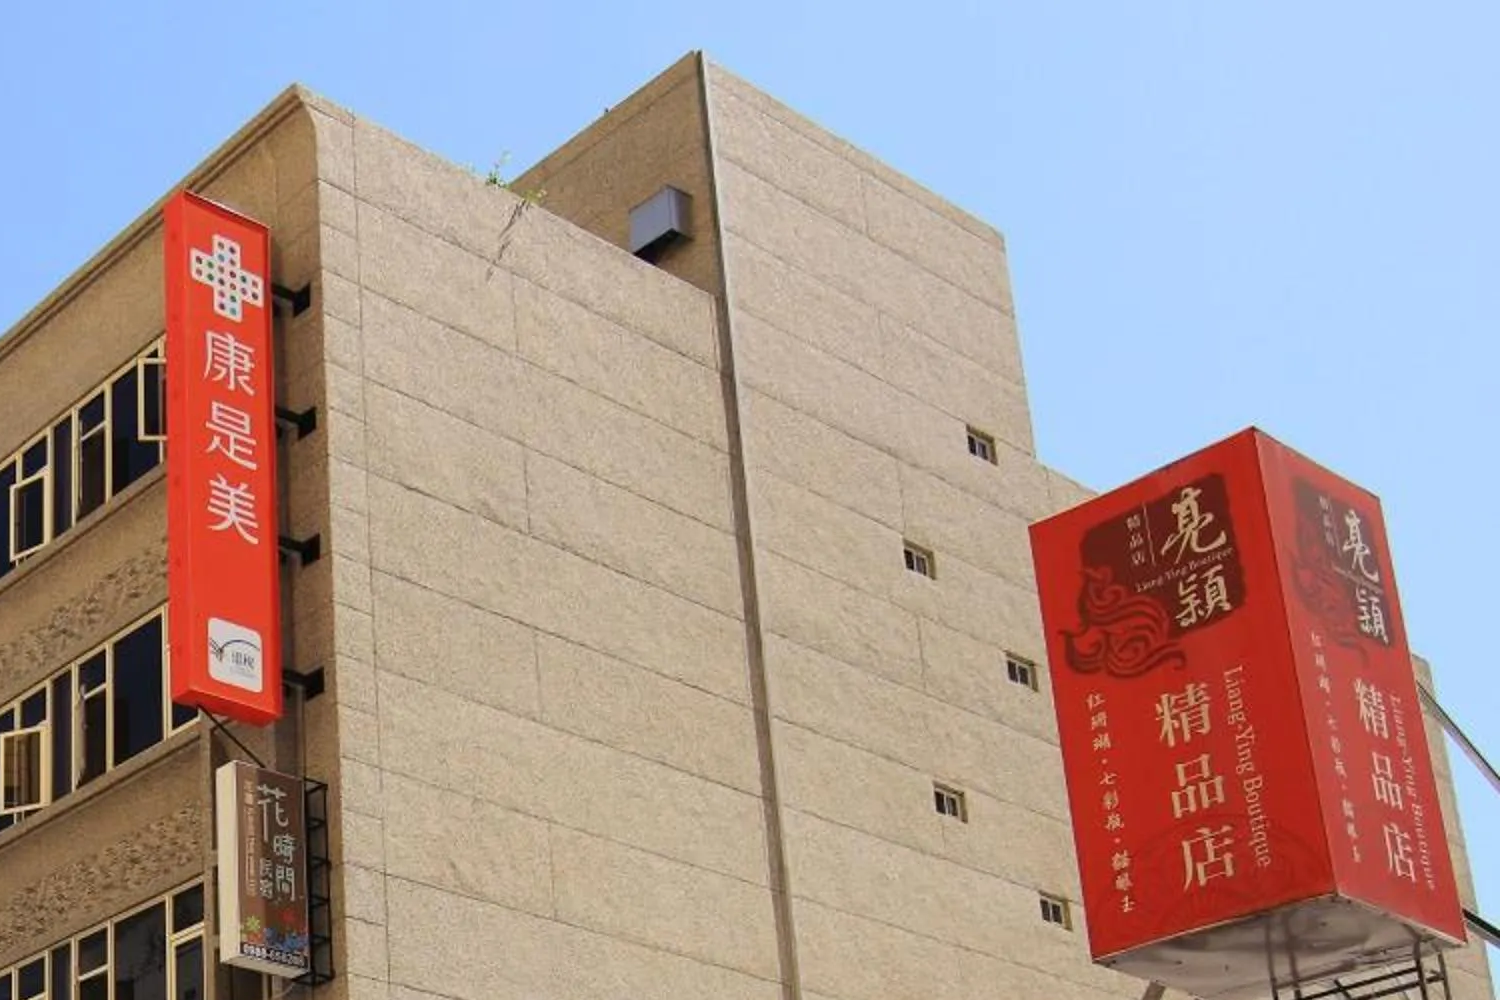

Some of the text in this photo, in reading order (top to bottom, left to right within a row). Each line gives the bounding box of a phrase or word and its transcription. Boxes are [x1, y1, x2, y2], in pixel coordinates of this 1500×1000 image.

[204, 330, 258, 545] 康是美
[1155, 682, 1235, 893] 精品店
[1243, 775, 1272, 869] Boutique
[1354, 678, 1415, 882] 精品店
